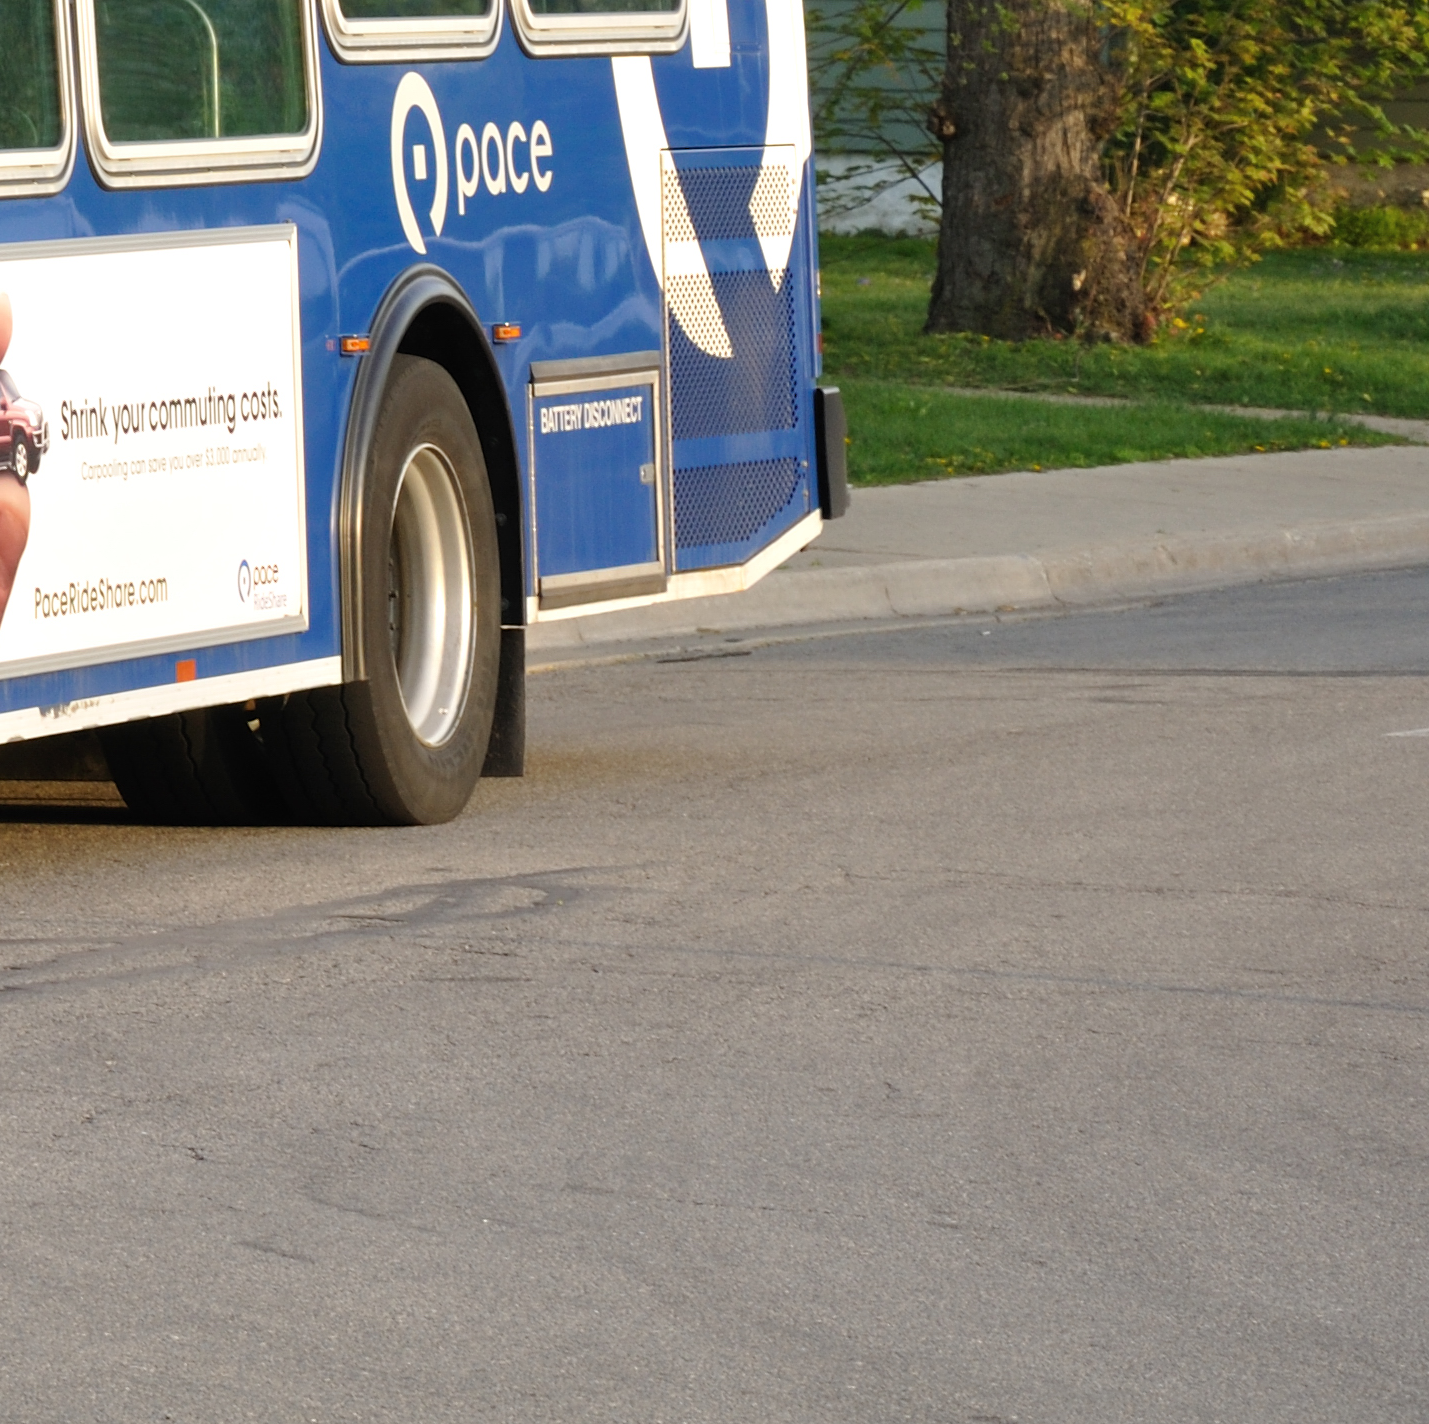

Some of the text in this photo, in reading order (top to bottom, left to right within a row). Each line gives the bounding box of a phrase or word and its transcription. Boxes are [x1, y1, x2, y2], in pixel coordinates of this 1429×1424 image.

[455, 118, 553, 216] pace
[60, 381, 283, 444] Shrink your commuting costs.
[541, 396, 643, 434] BATTERY DISCONNECT
[81, 459, 128, 482] Carpooling
[130, 459, 146, 475] can
[148, 456, 167, 473] save
[169, 455, 184, 474] you
[186, 452, 203, 470] over
[253, 564, 279, 590] pace
[34, 577, 168, 619] PaceRideShare.com
[253, 592, 288, 611] RideShare
